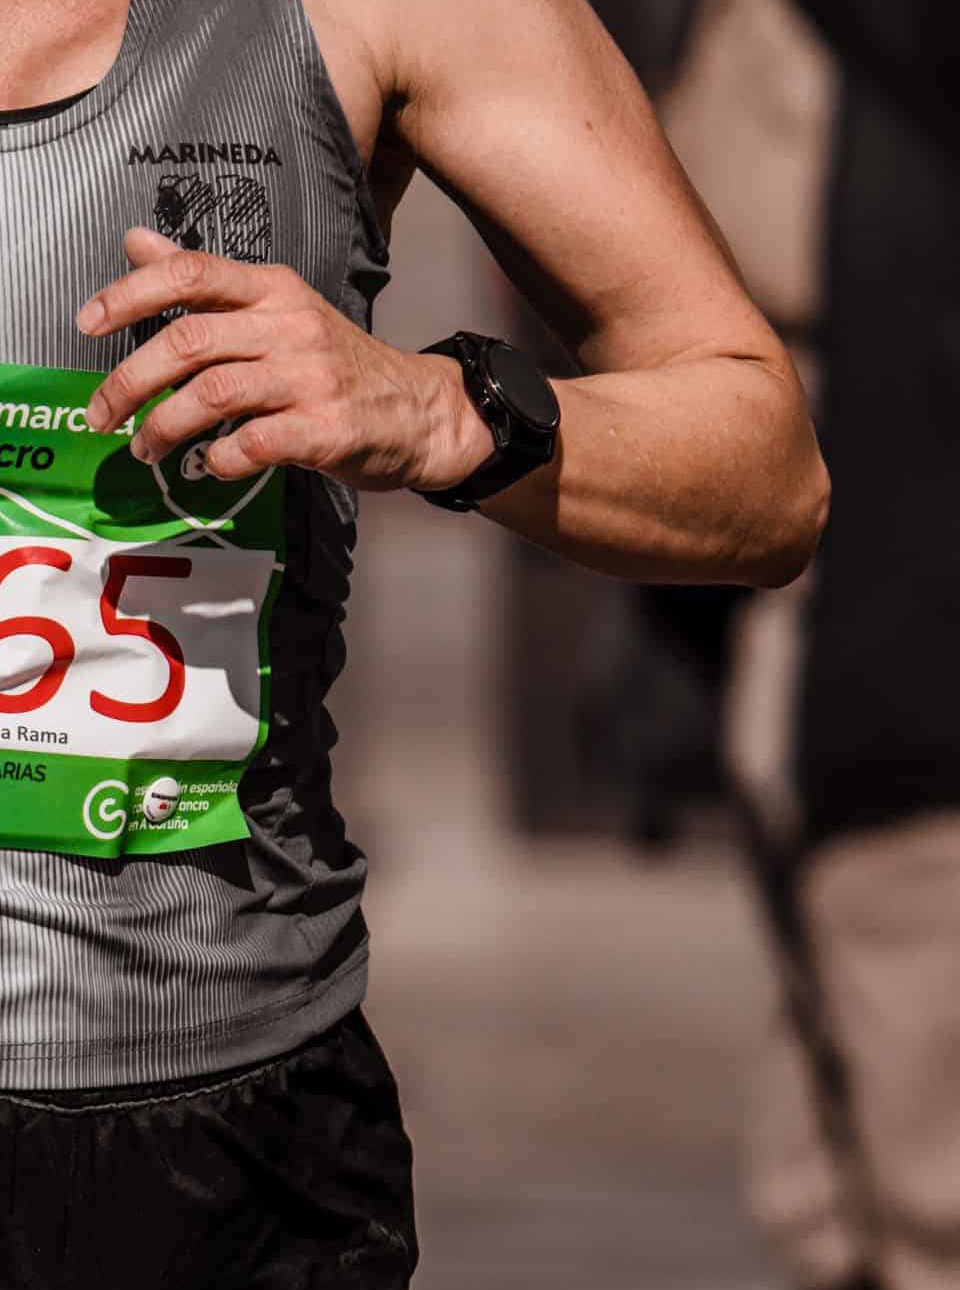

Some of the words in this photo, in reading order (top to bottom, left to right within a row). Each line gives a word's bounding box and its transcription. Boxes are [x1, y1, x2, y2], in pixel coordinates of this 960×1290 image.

[128, 142, 283, 166] MARINEDA
[17, 725, 69, 745] Rama
[189, 779, 239, 797] española
